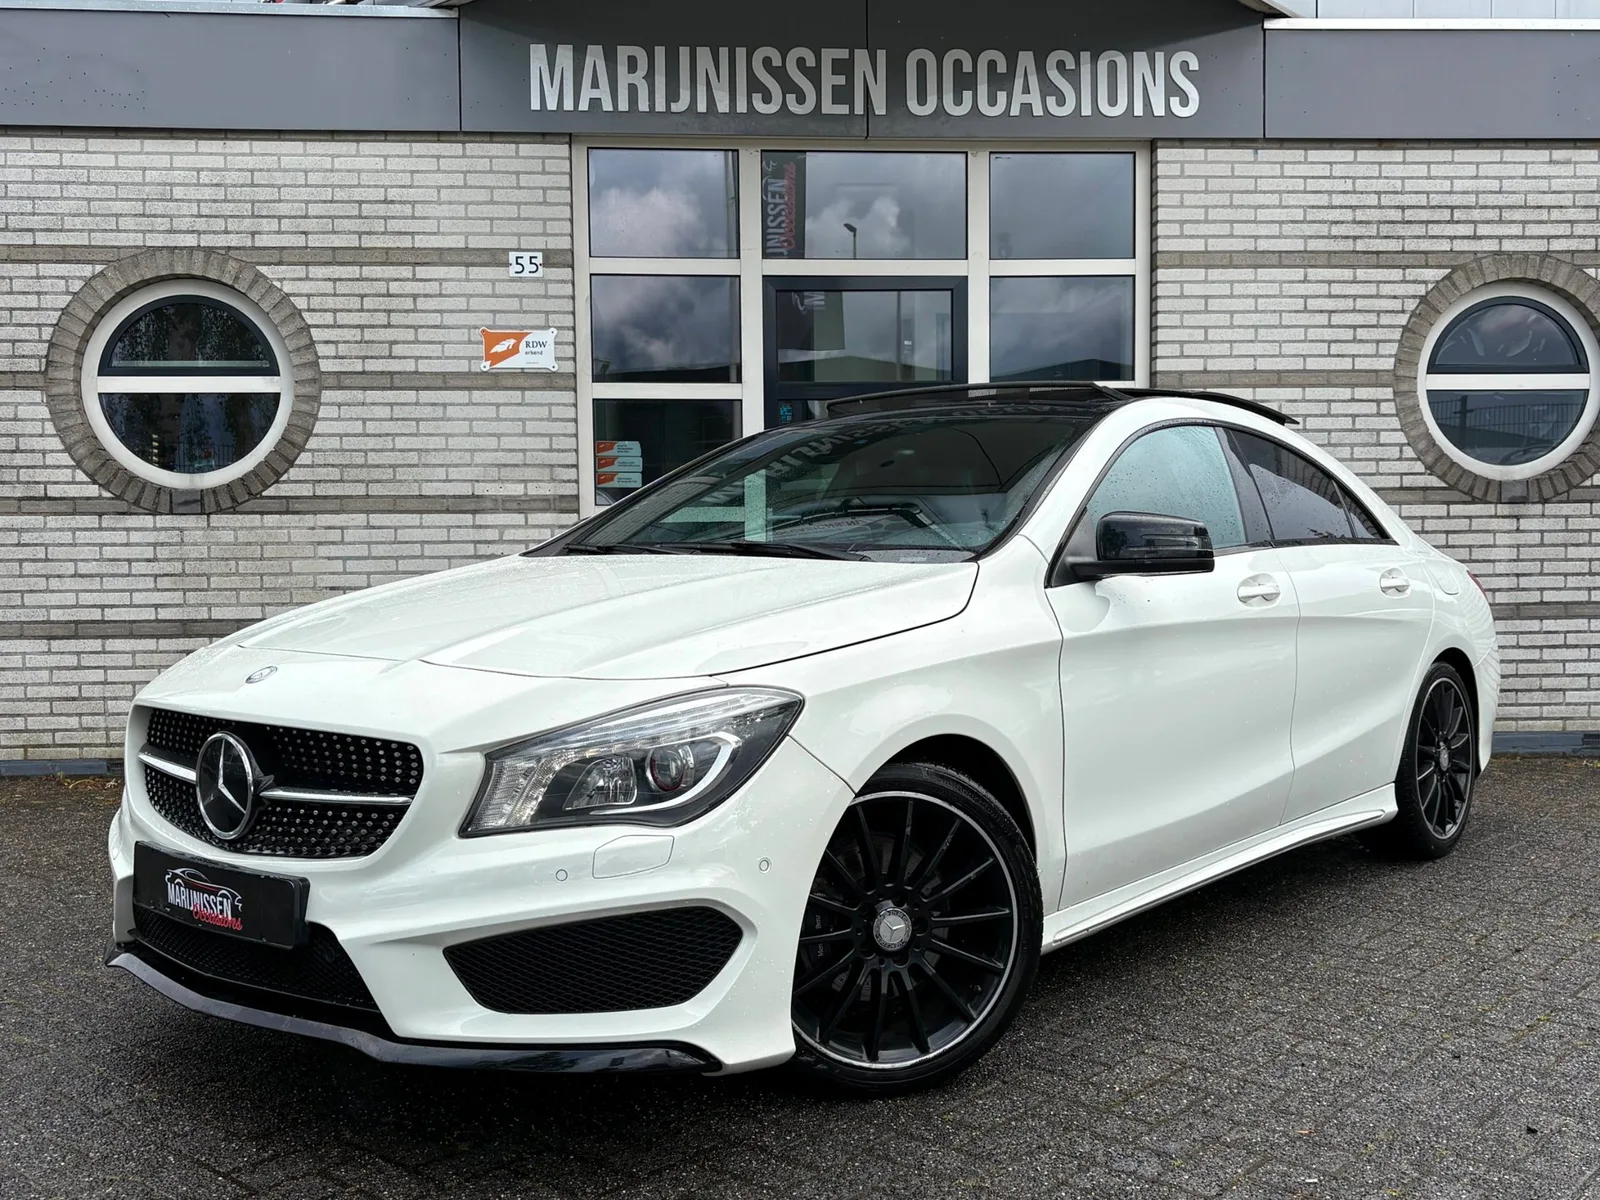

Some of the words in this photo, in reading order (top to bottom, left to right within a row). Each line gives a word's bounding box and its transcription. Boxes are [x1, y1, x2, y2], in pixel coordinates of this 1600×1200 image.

[528, 43, 887, 115] MARIJNISSEN
[904, 47, 1201, 118] OCCASIONS
[514, 255, 540, 275] 55
[525, 340, 548, 349] RDW
[167, 882, 232, 920] MARIJNISSEN
[192, 902, 243, 931] Occasions
